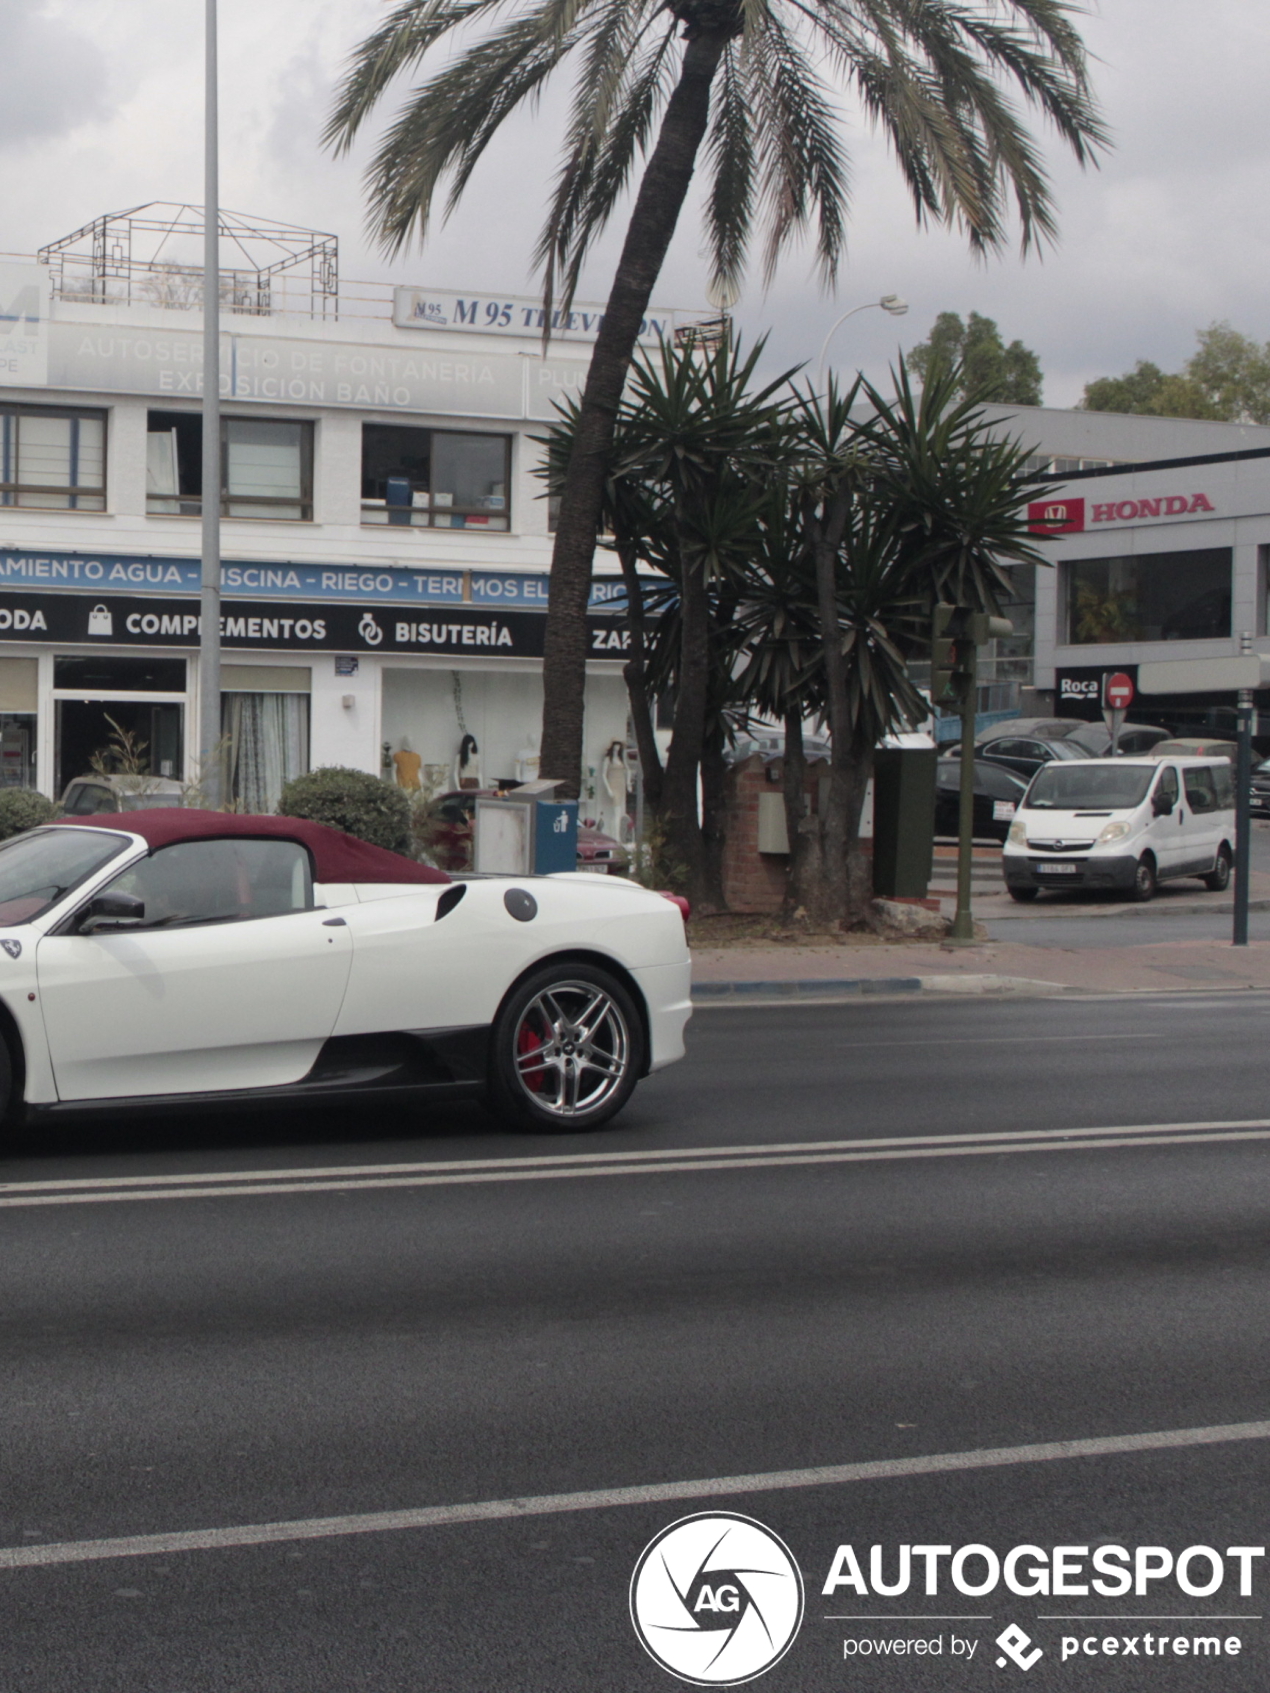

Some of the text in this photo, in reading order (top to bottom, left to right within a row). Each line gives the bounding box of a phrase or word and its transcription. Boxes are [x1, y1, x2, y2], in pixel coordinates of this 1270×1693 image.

[428, 302, 442, 316] 95
[452, 299, 479, 325] M
[483, 302, 513, 328] 95
[291, 349, 322, 373] DE
[334, 352, 495, 385] FONTANERÍA
[336, 381, 411, 406] BAÑO
[1091, 493, 1215, 523] HONDA
[109, 563, 182, 583] AGUA
[220, 567, 301, 588] ISCINA
[321, 572, 394, 592] RIEGO
[125, 612, 327, 641] COMPMENTOS
[395, 621, 513, 647] BISUTERÍA
[1061, 678, 1099, 693] Roca
